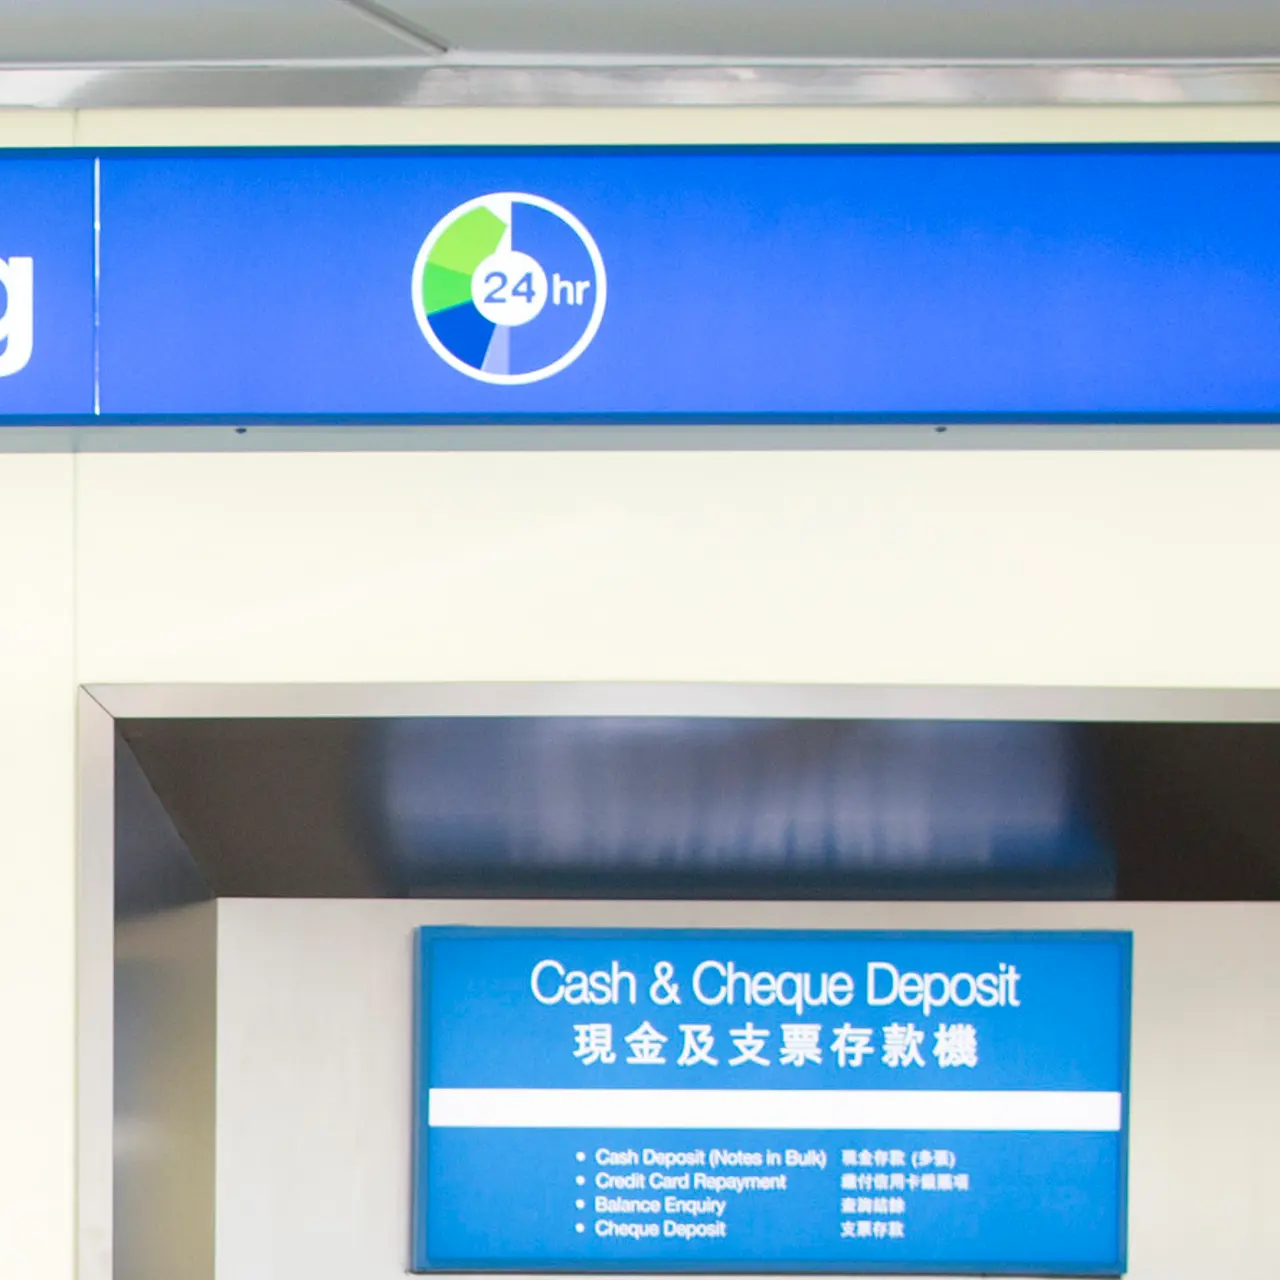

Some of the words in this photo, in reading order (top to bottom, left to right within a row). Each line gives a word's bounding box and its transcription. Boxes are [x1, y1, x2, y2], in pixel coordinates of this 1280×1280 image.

[530, 960, 638, 1007] Cash
[649, 963, 680, 1006] &
[692, 961, 854, 1016] Cheque
[866, 962, 1021, 1016] Deposit
[574, 1022, 980, 1068] 現金及支票存款機
[595, 1148, 638, 1166] Cash
[642, 1149, 705, 1170] Deposit
[709, 1149, 763, 1170] (Notes
[766, 1149, 781, 1166] in
[785, 1149, 828, 1170] Bulk)
[595, 1172, 645, 1190] Credit
[649, 1172, 690, 1190] Card
[693, 1173, 787, 1194] Repayment
[595, 1197, 660, 1214] Balance
[664, 1197, 727, 1218] Enquiry
[595, 1221, 660, 1240] Cheque
[663, 1221, 727, 1241] Deposit
